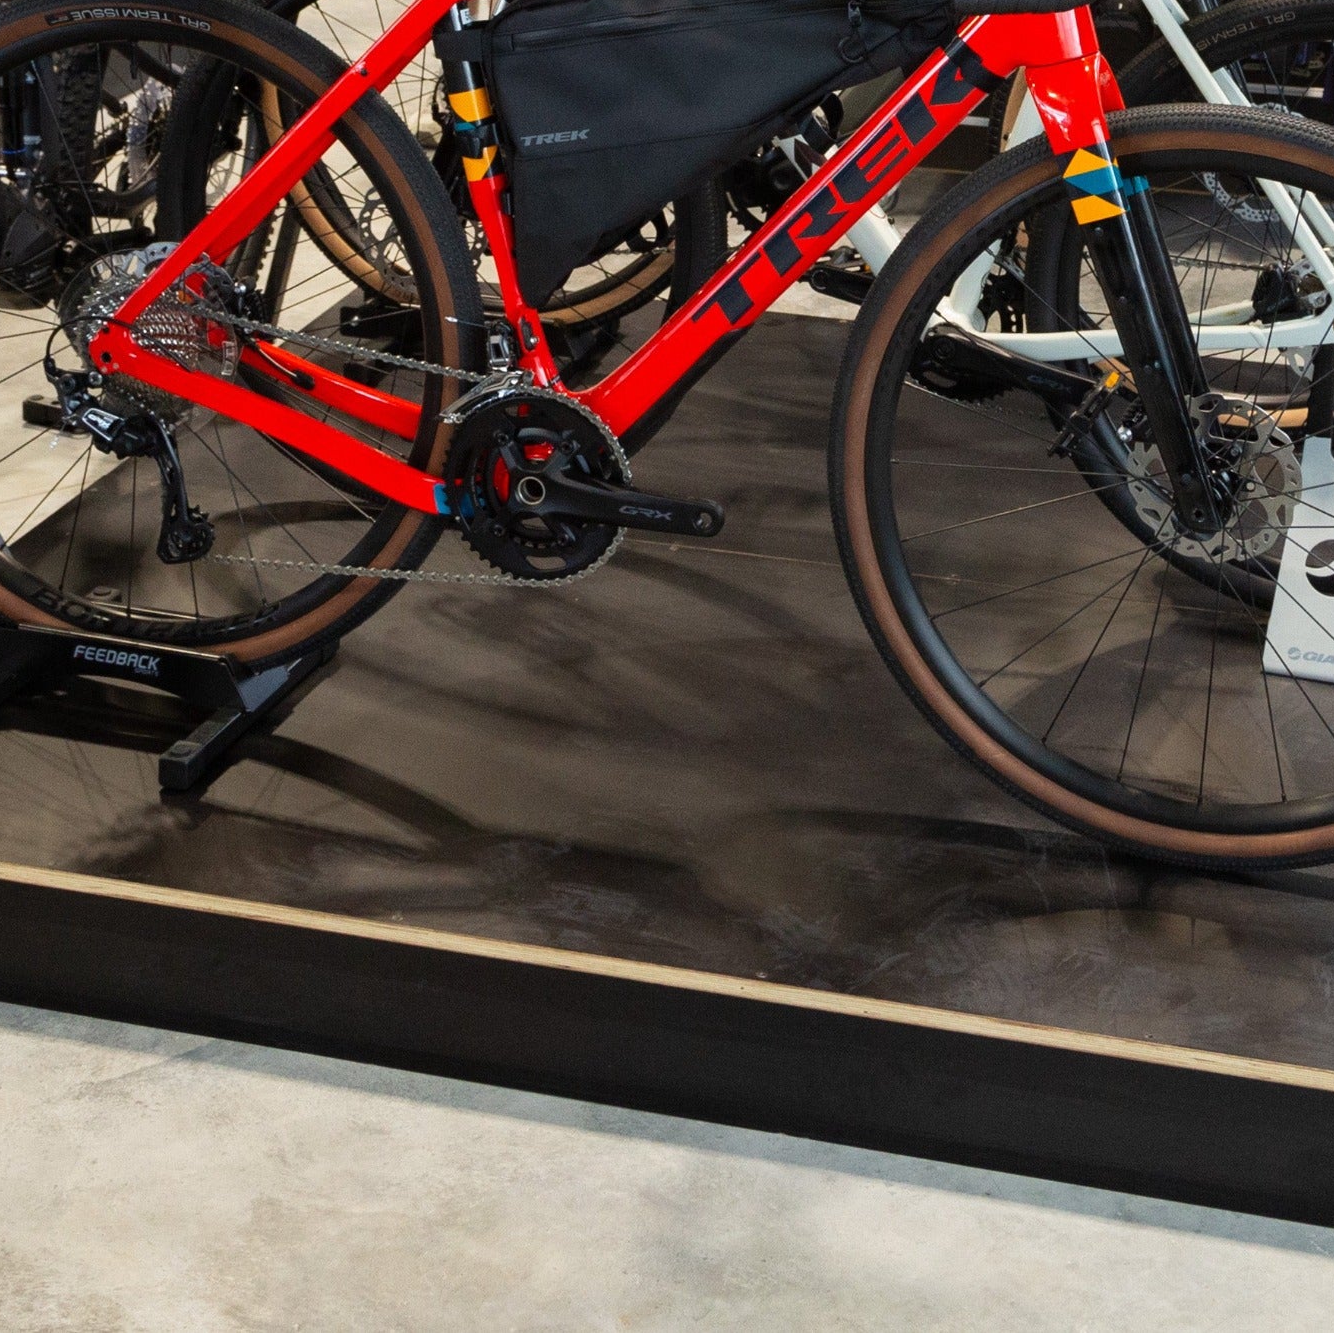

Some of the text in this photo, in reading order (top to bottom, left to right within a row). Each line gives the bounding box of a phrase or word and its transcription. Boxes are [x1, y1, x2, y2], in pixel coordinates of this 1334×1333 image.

[70, 7, 120, 22] ISSUE
[122, 8, 172, 23] TEAM
[520, 129, 590, 147] TREK
[691, 60, 980, 326] TREK
[619, 505, 672, 521] GRX
[73, 644, 161, 671] FEEDBACK
